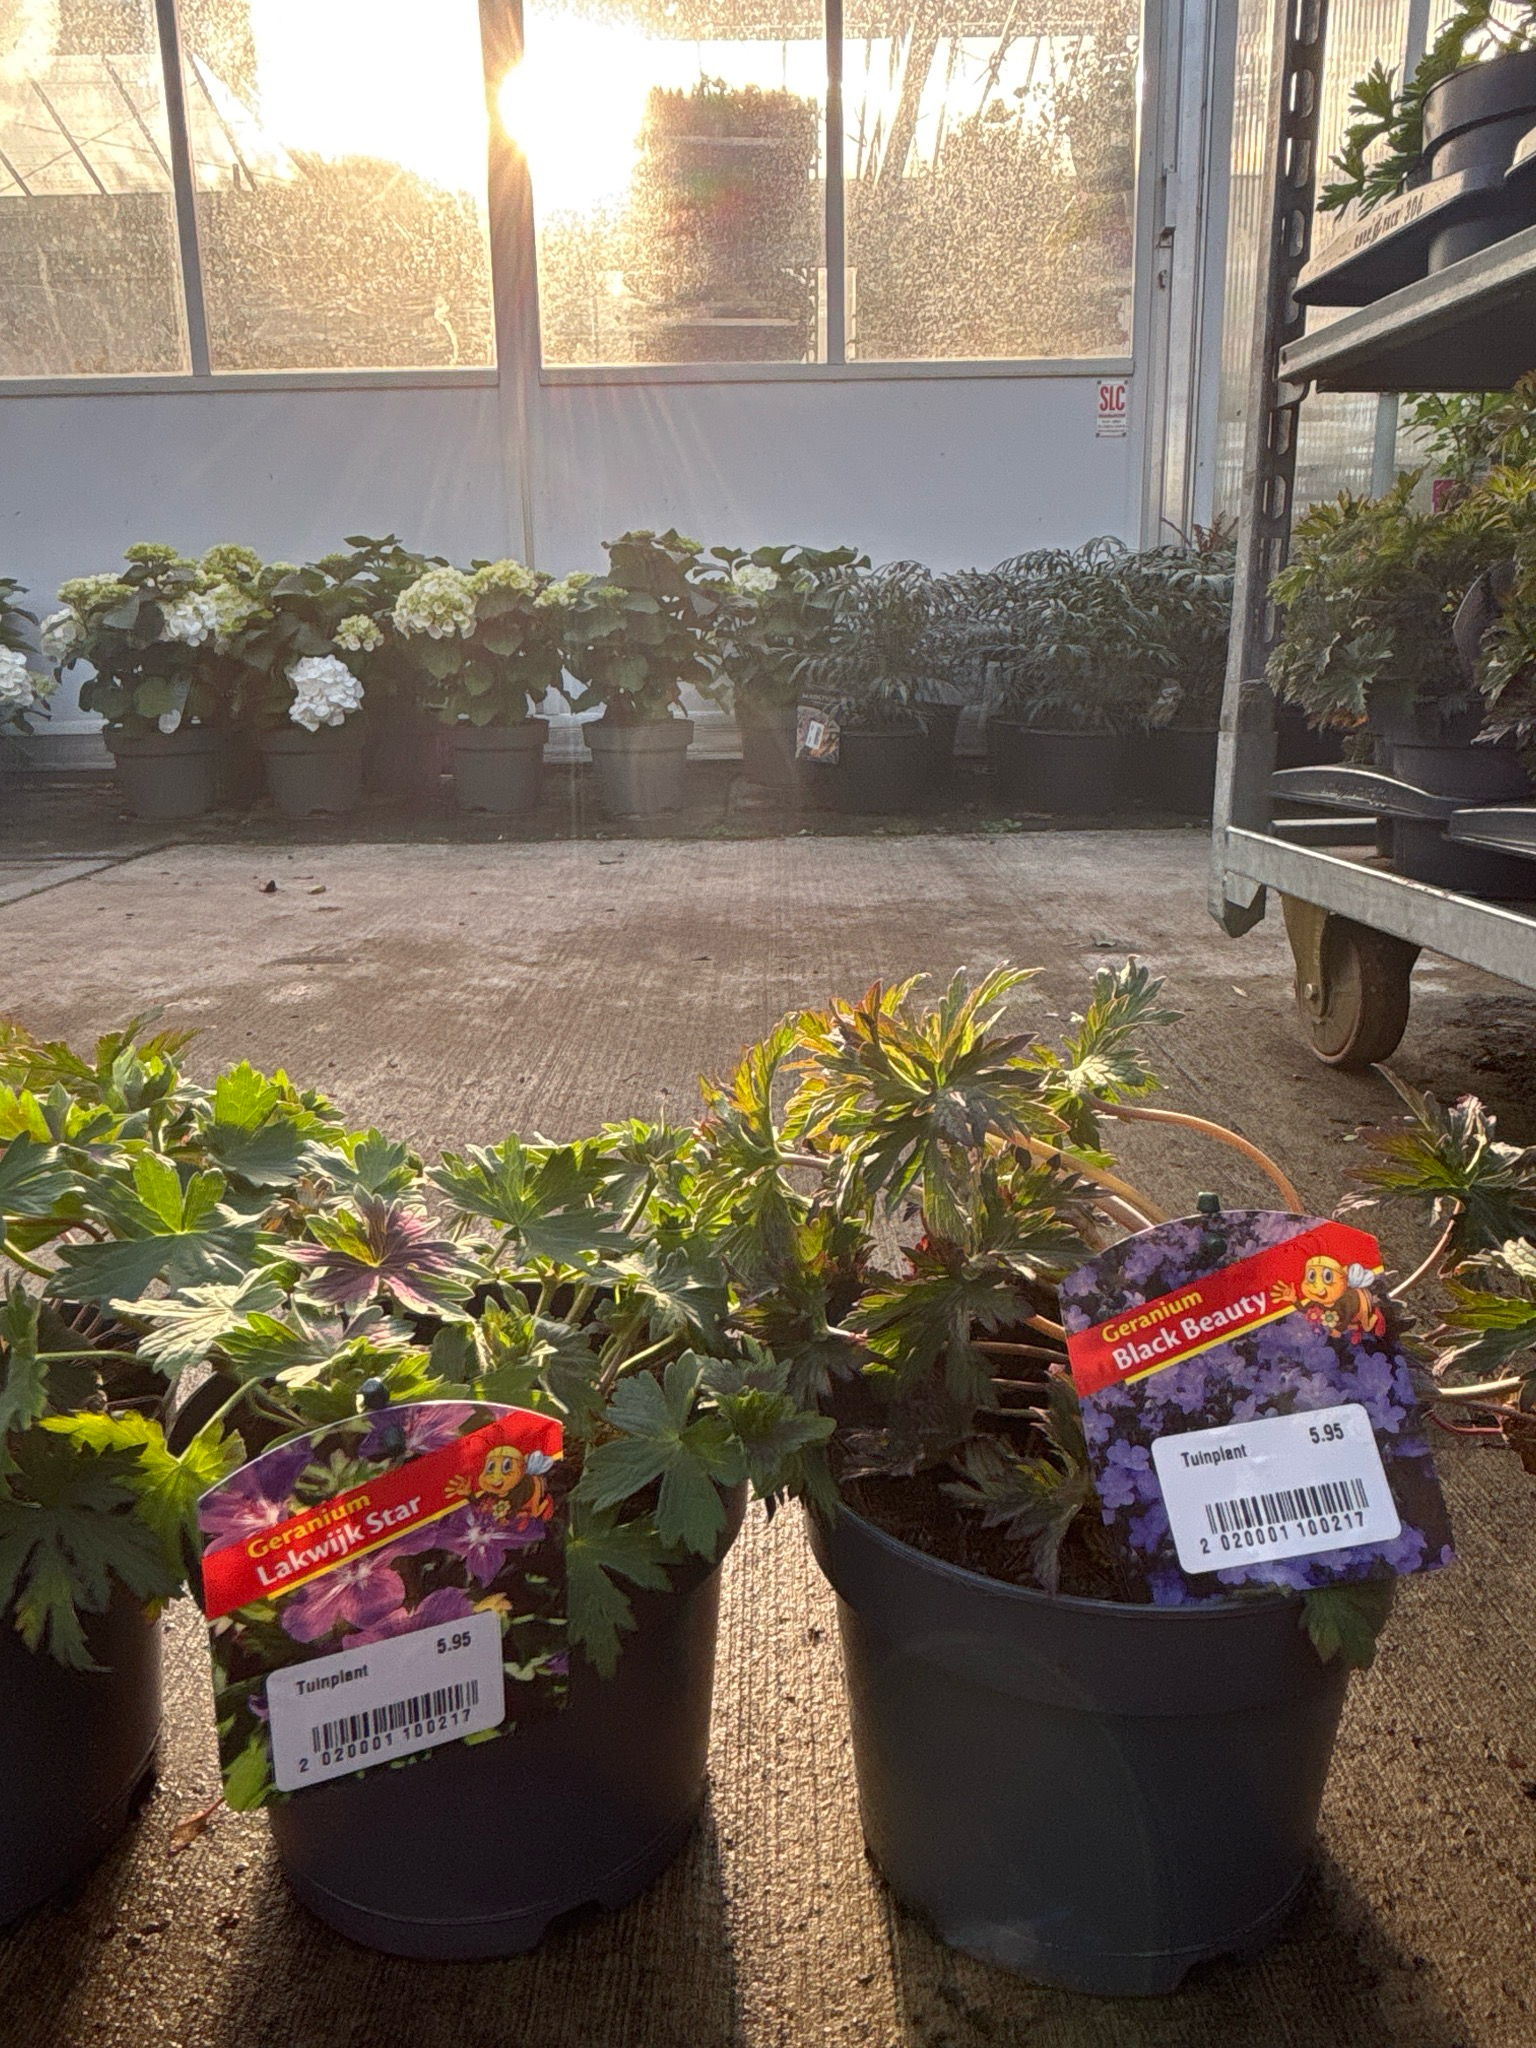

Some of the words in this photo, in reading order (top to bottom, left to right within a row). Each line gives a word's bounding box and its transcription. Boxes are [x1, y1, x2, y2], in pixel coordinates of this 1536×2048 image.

[1100, 385, 1126, 411] SLC
[1102, 1291, 1203, 1343] Geranium
[1111, 1328, 1182, 1370] Black
[1180, 1291, 1266, 1340] Beauty
[1309, 1423, 1344, 1444] 5.95
[1180, 1444, 1248, 1467] Tuinplant
[247, 1495, 371, 1558] Geranium
[256, 1523, 365, 1586] Lakwijk
[366, 1496, 421, 1534] Star
[1200, 1538, 1211, 1554] 2
[1220, 1525, 1289, 1550] 020001
[1297, 1511, 1365, 1537] 100217
[436, 1631, 472, 1654] 5.95
[296, 1664, 369, 1695] Tuinplant
[299, 1758, 310, 1773] 2
[322, 1733, 393, 1766] 020001
[403, 1708, 471, 1741] 100217
